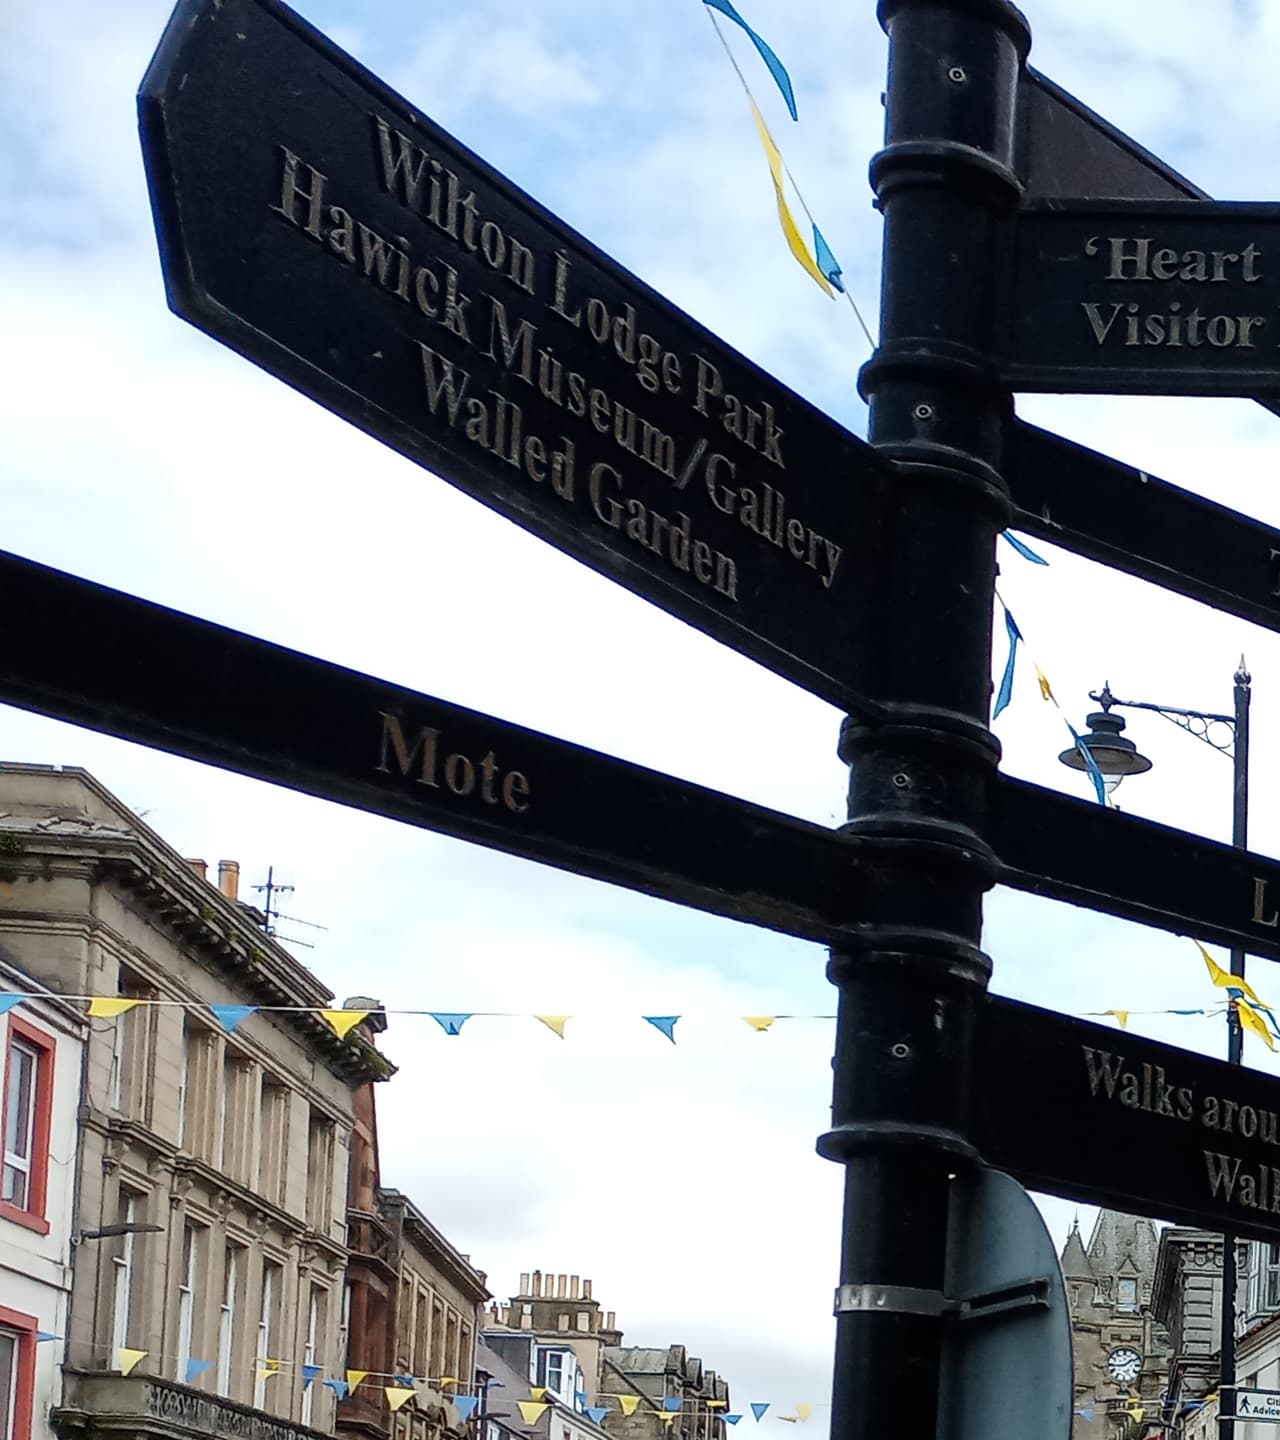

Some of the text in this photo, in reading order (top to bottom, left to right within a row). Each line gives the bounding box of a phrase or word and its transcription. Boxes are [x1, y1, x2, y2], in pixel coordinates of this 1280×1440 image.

[370, 112, 788, 469] Wilton Lodge Park
[1081, 301, 1263, 350] Visitor
[272, 145, 844, 590] Hawick Museum/Gallery
[414, 340, 740, 601] Walled Garden
[375, 709, 531, 814] Mote
[1081, 1045, 1194, 1118] Walks
[1253, 1406, 1280, 1416] Advice
